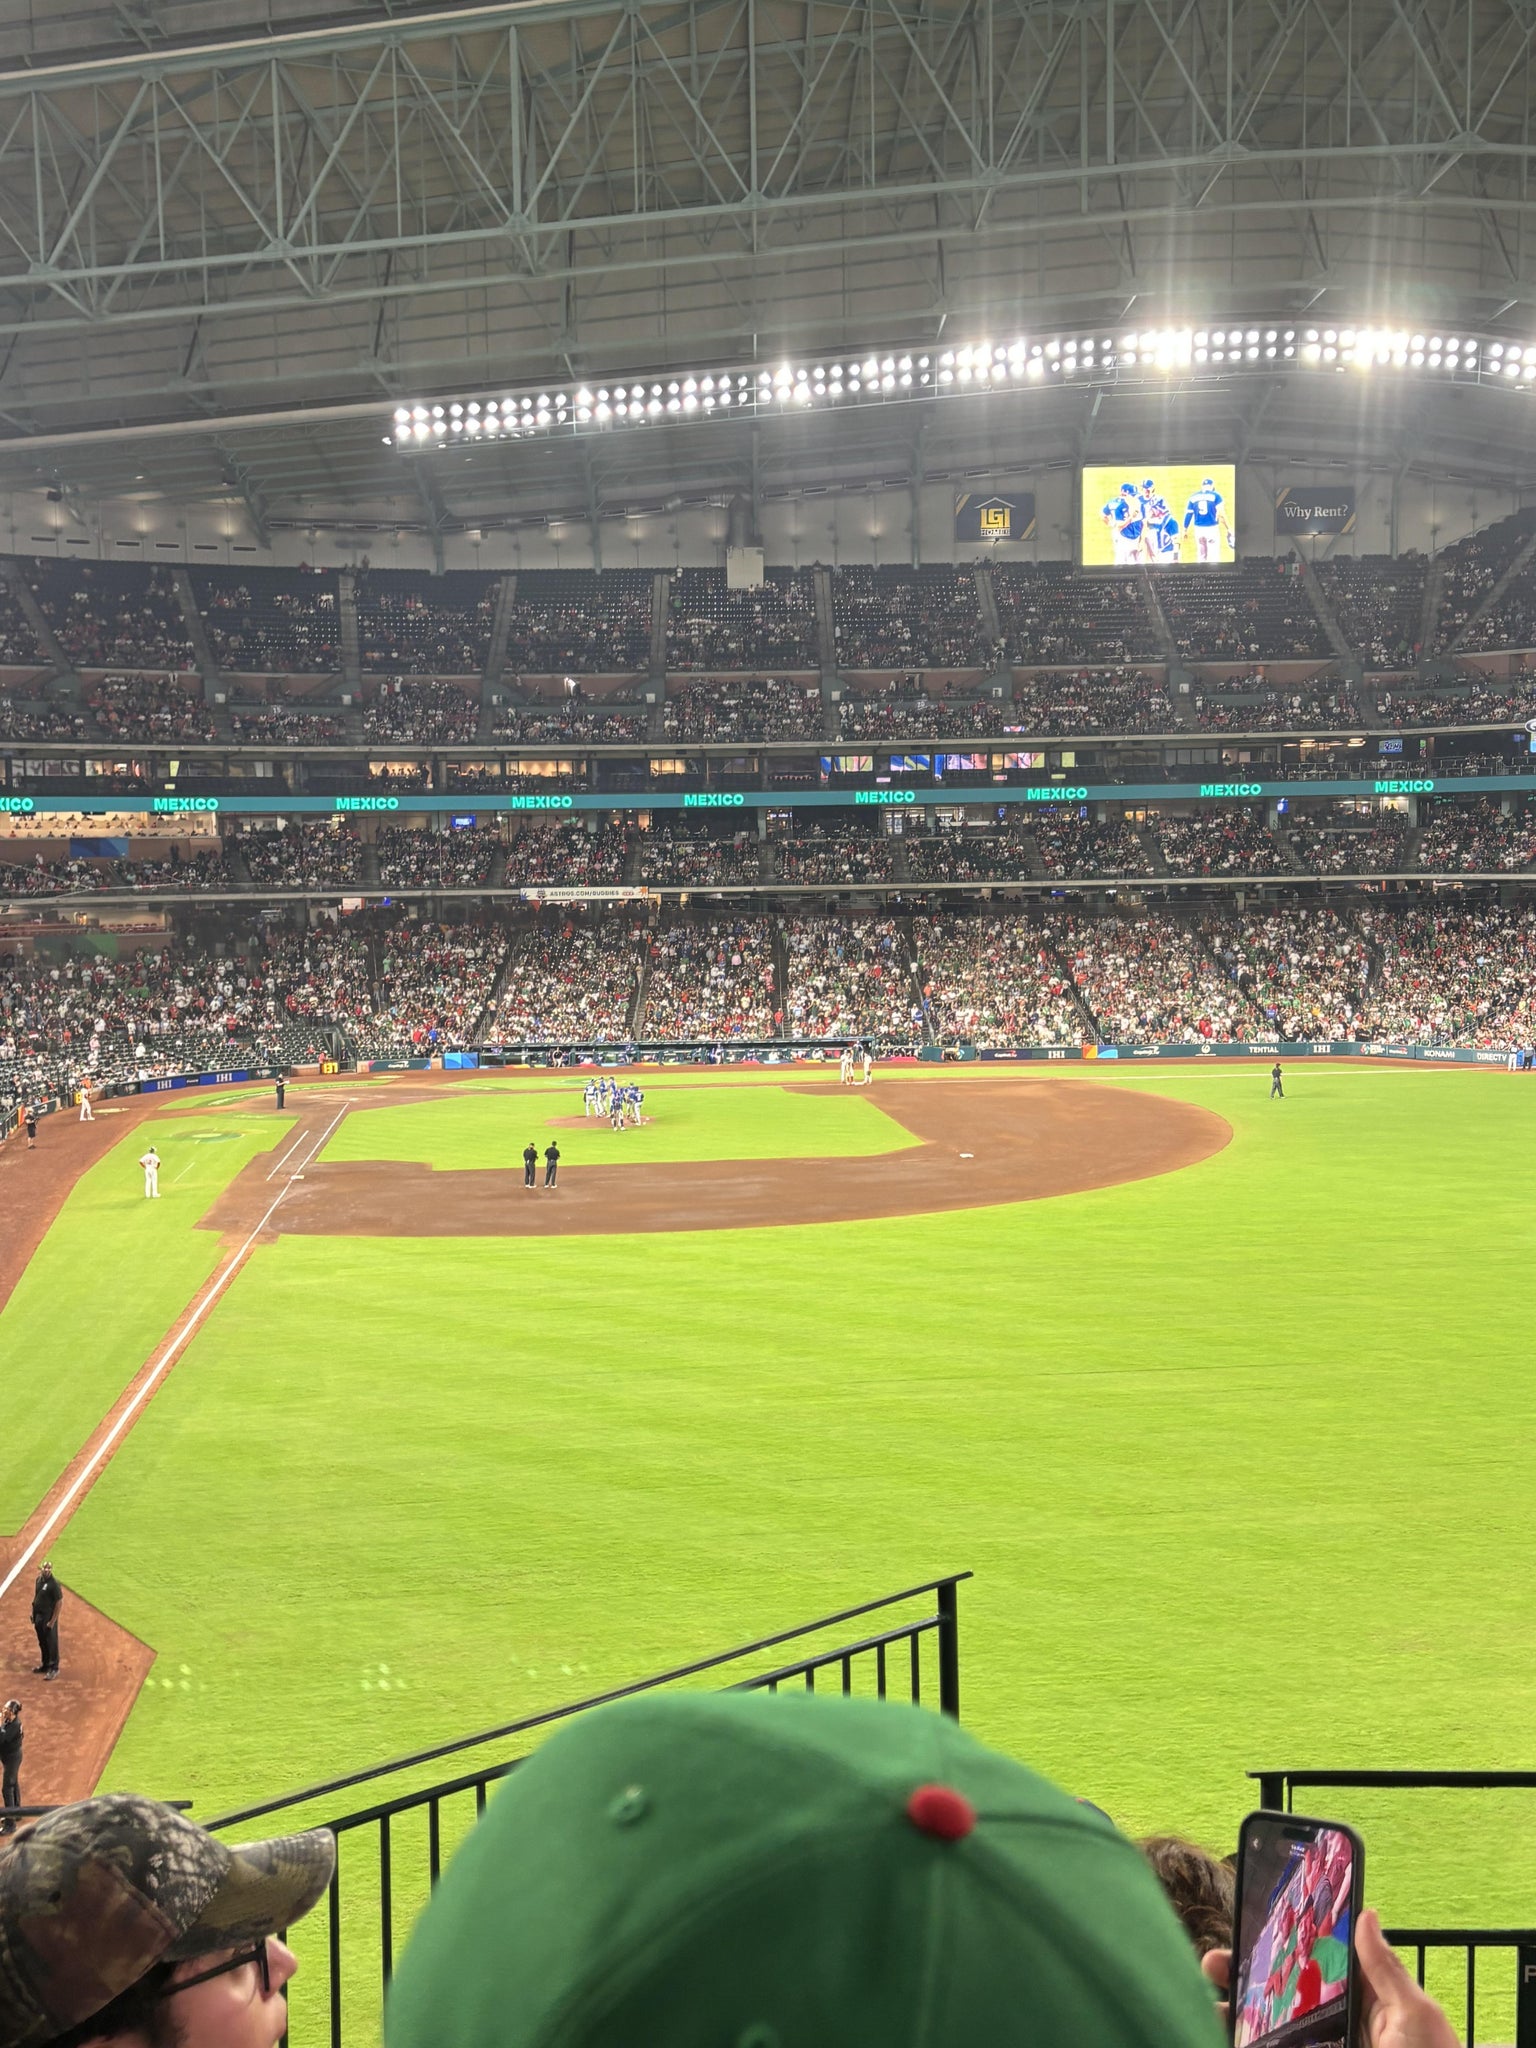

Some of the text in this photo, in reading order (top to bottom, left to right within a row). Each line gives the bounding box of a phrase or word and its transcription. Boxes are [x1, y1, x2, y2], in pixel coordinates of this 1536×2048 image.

[981, 508, 1010, 528] LGI
[1284, 504, 1348, 520] Why Rent?
[1201, 785, 1262, 797] MEXICO
[1374, 780, 1434, 793] MEXICO
[856, 792, 915, 804] MEXICO
[1027, 788, 1088, 801] MEXICO
[154, 798, 218, 811] MEXICO
[336, 797, 399, 810] MEXICO
[512, 796, 572, 809] MEXICO
[684, 795, 744, 807] MEXICO
[1048, 1051, 1065, 1059] IHI
[1313, 1045, 1331, 1053] IHI
[1424, 1050, 1455, 1059] KONAMI
[1476, 1052, 1507, 1062] DIRECTV
[216, 1073, 233, 1082] IHI
[157, 1080, 172, 1090] IHI
